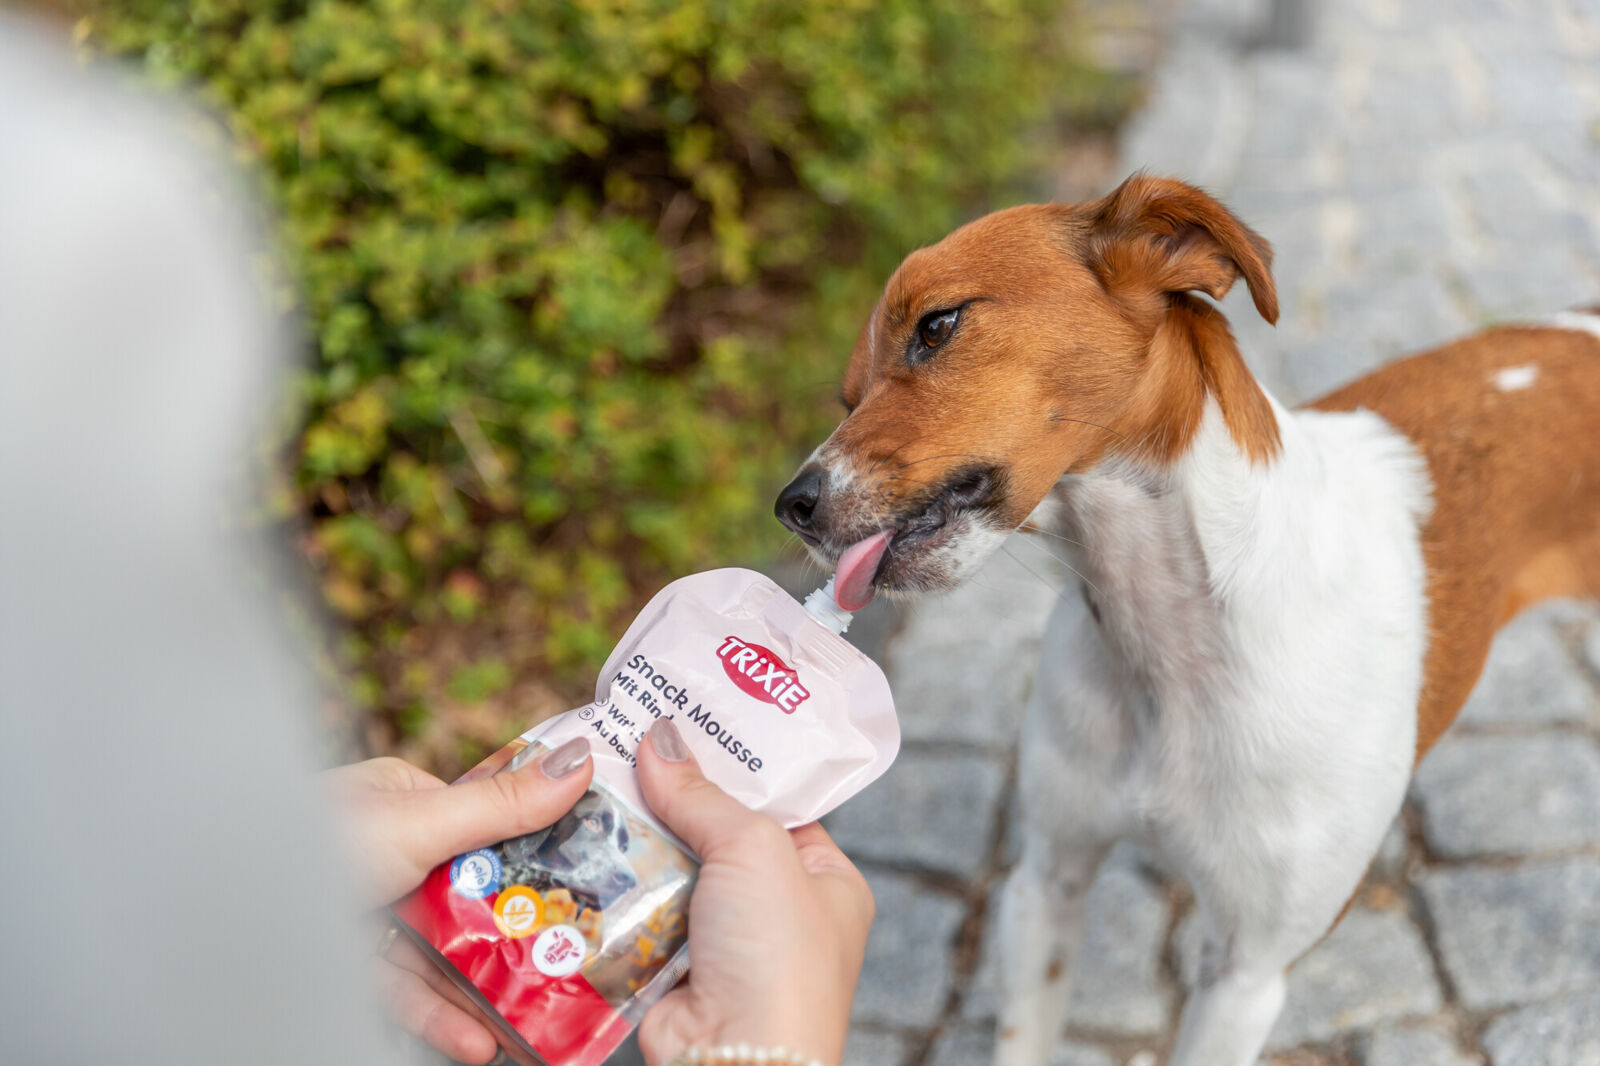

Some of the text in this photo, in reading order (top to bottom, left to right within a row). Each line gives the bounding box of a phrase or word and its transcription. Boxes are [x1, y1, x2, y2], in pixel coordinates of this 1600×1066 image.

[611, 671, 638, 697] Mit
[627, 654, 763, 773] Snack Mousse
[591, 720, 609, 739] Au
